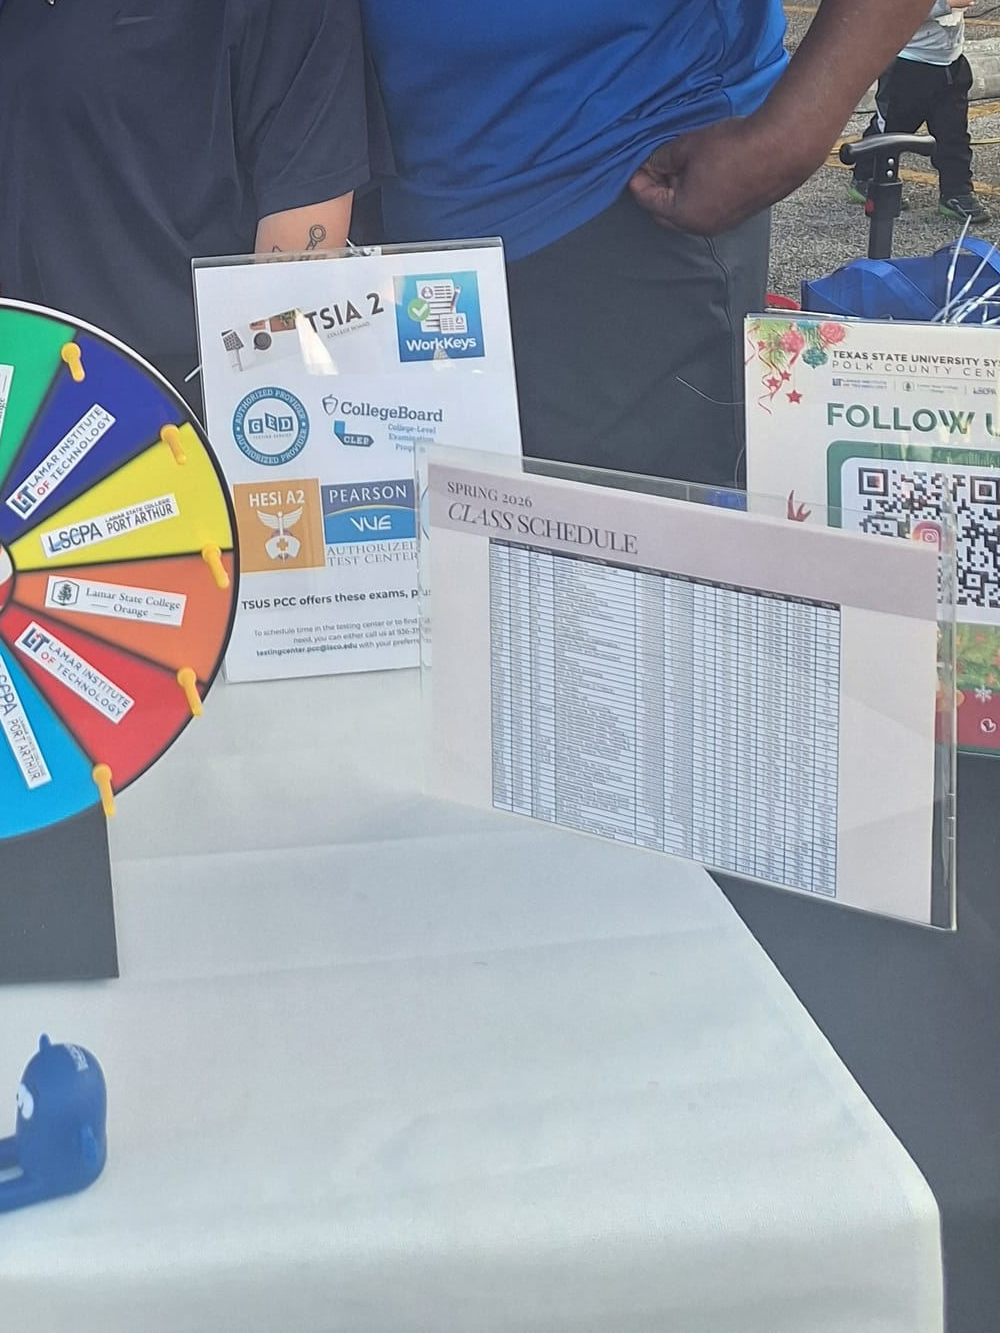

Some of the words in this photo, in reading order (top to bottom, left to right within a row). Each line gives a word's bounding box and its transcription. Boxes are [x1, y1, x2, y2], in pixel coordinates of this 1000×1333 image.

[304, 300, 362, 333] TSIA
[366, 292, 384, 315] 2
[406, 337, 476, 351] WorkKeys
[832, 360, 873, 370] POLK
[885, 363, 951, 374] COUNTY
[833, 351, 868, 360] TEXAS
[872, 352, 908, 362] STATE
[912, 354, 980, 366] UNIVERSITY
[340, 402, 443, 422] CollegeBoard
[827, 402, 975, 434] FOLLOW
[251, 416, 291, 432] GED
[27, 454, 59, 487] LAMAR
[59, 407, 103, 456] INSTITUTE
[344, 435, 370, 445] CLEP
[37, 481, 50, 495] OF
[50, 414, 111, 481] TECHNOLOGY
[287, 490, 305, 504] A2
[329, 485, 408, 504] PEARSON
[448, 481, 498, 501] SPRING
[502, 493, 533, 507] 2026
[107, 517, 132, 534] PORT
[135, 504, 174, 525] ARTHUR
[350, 515, 392, 532] VUE
[449, 502, 514, 530] CLASS
[518, 514, 638, 554] SCHEDULE
[48, 522, 103, 552] LSCPA
[329, 555, 361, 566] TEST
[365, 552, 418, 563] CENTER
[86, 588, 117, 600] Lamar
[119, 592, 143, 604] State
[145, 597, 181, 610] College
[241, 599, 270, 610] TSUS
[274, 597, 296, 607] PCC
[299, 594, 332, 606] offers
[335, 592, 366, 603] these
[369, 589, 408, 600] exams,
[113, 604, 148, 618] Orange
[336, 622, 361, 632] testing
[359, 641, 375, 649] with
[40, 652, 56, 664] OF
[57, 663, 123, 716] TECHNOLOGY
[49, 642, 82, 671] LAMAR
[82, 667, 131, 708] INSTITUTE
[8, 718, 26, 741] PORT
[17, 743, 42, 781] ARTHUR
